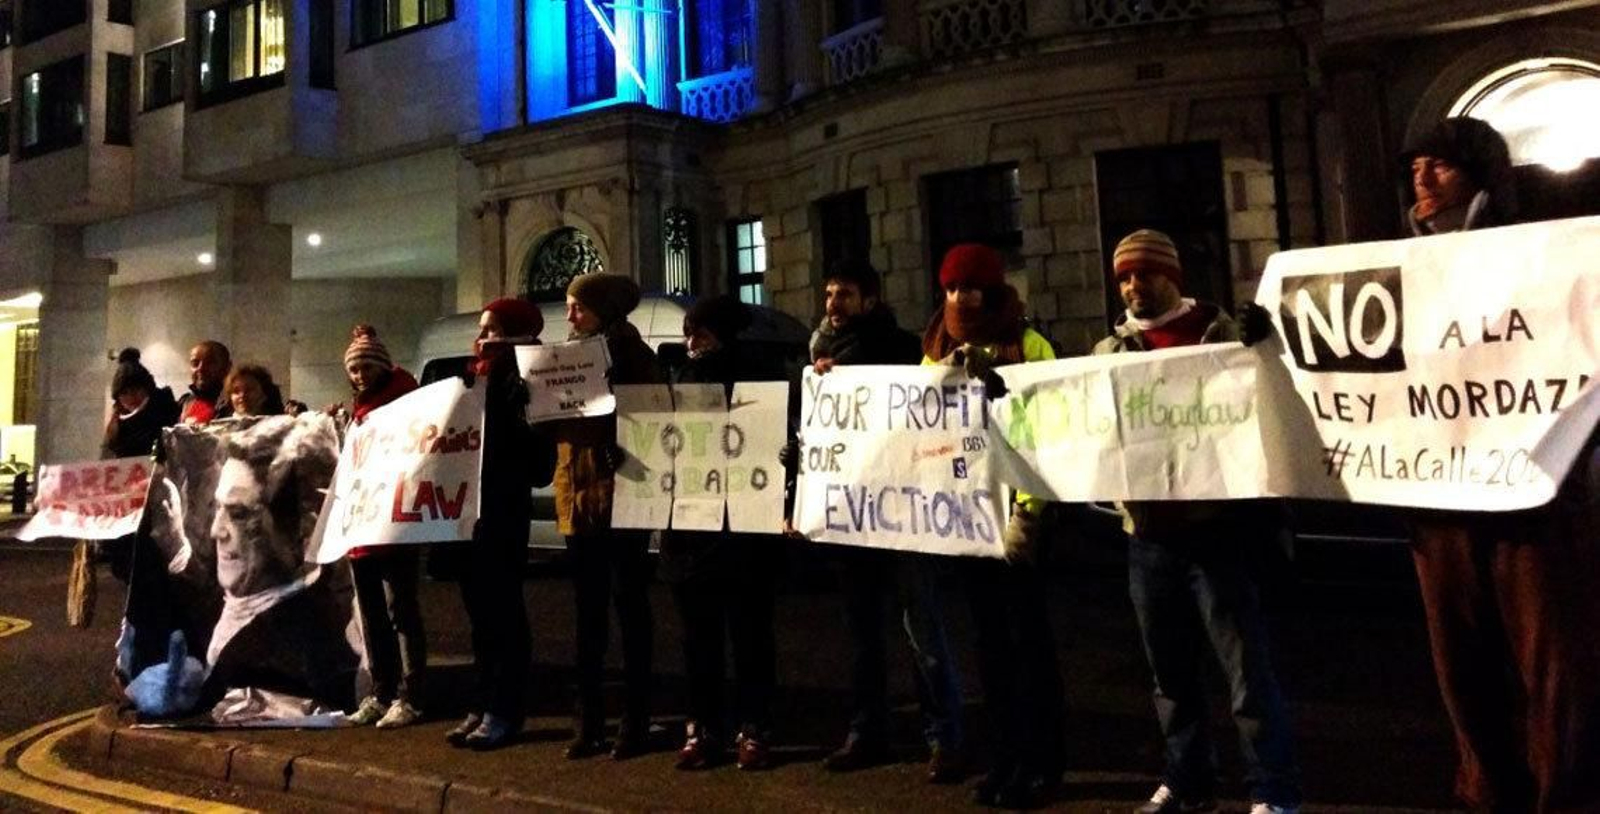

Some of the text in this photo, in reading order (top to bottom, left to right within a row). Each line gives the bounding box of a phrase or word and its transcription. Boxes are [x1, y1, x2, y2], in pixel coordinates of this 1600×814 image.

[1296, 281, 1534, 365] NO A LA
[545, 374, 586, 387] FRANCO
[1313, 374, 1590, 423] LEY MORDAZ
[559, 399, 586, 411] BACK
[806, 375, 871, 431] YOUR
[631, 421, 745, 459] VOTO
[809, 443, 846, 473] OUR
[392, 472, 469, 523] LAW
